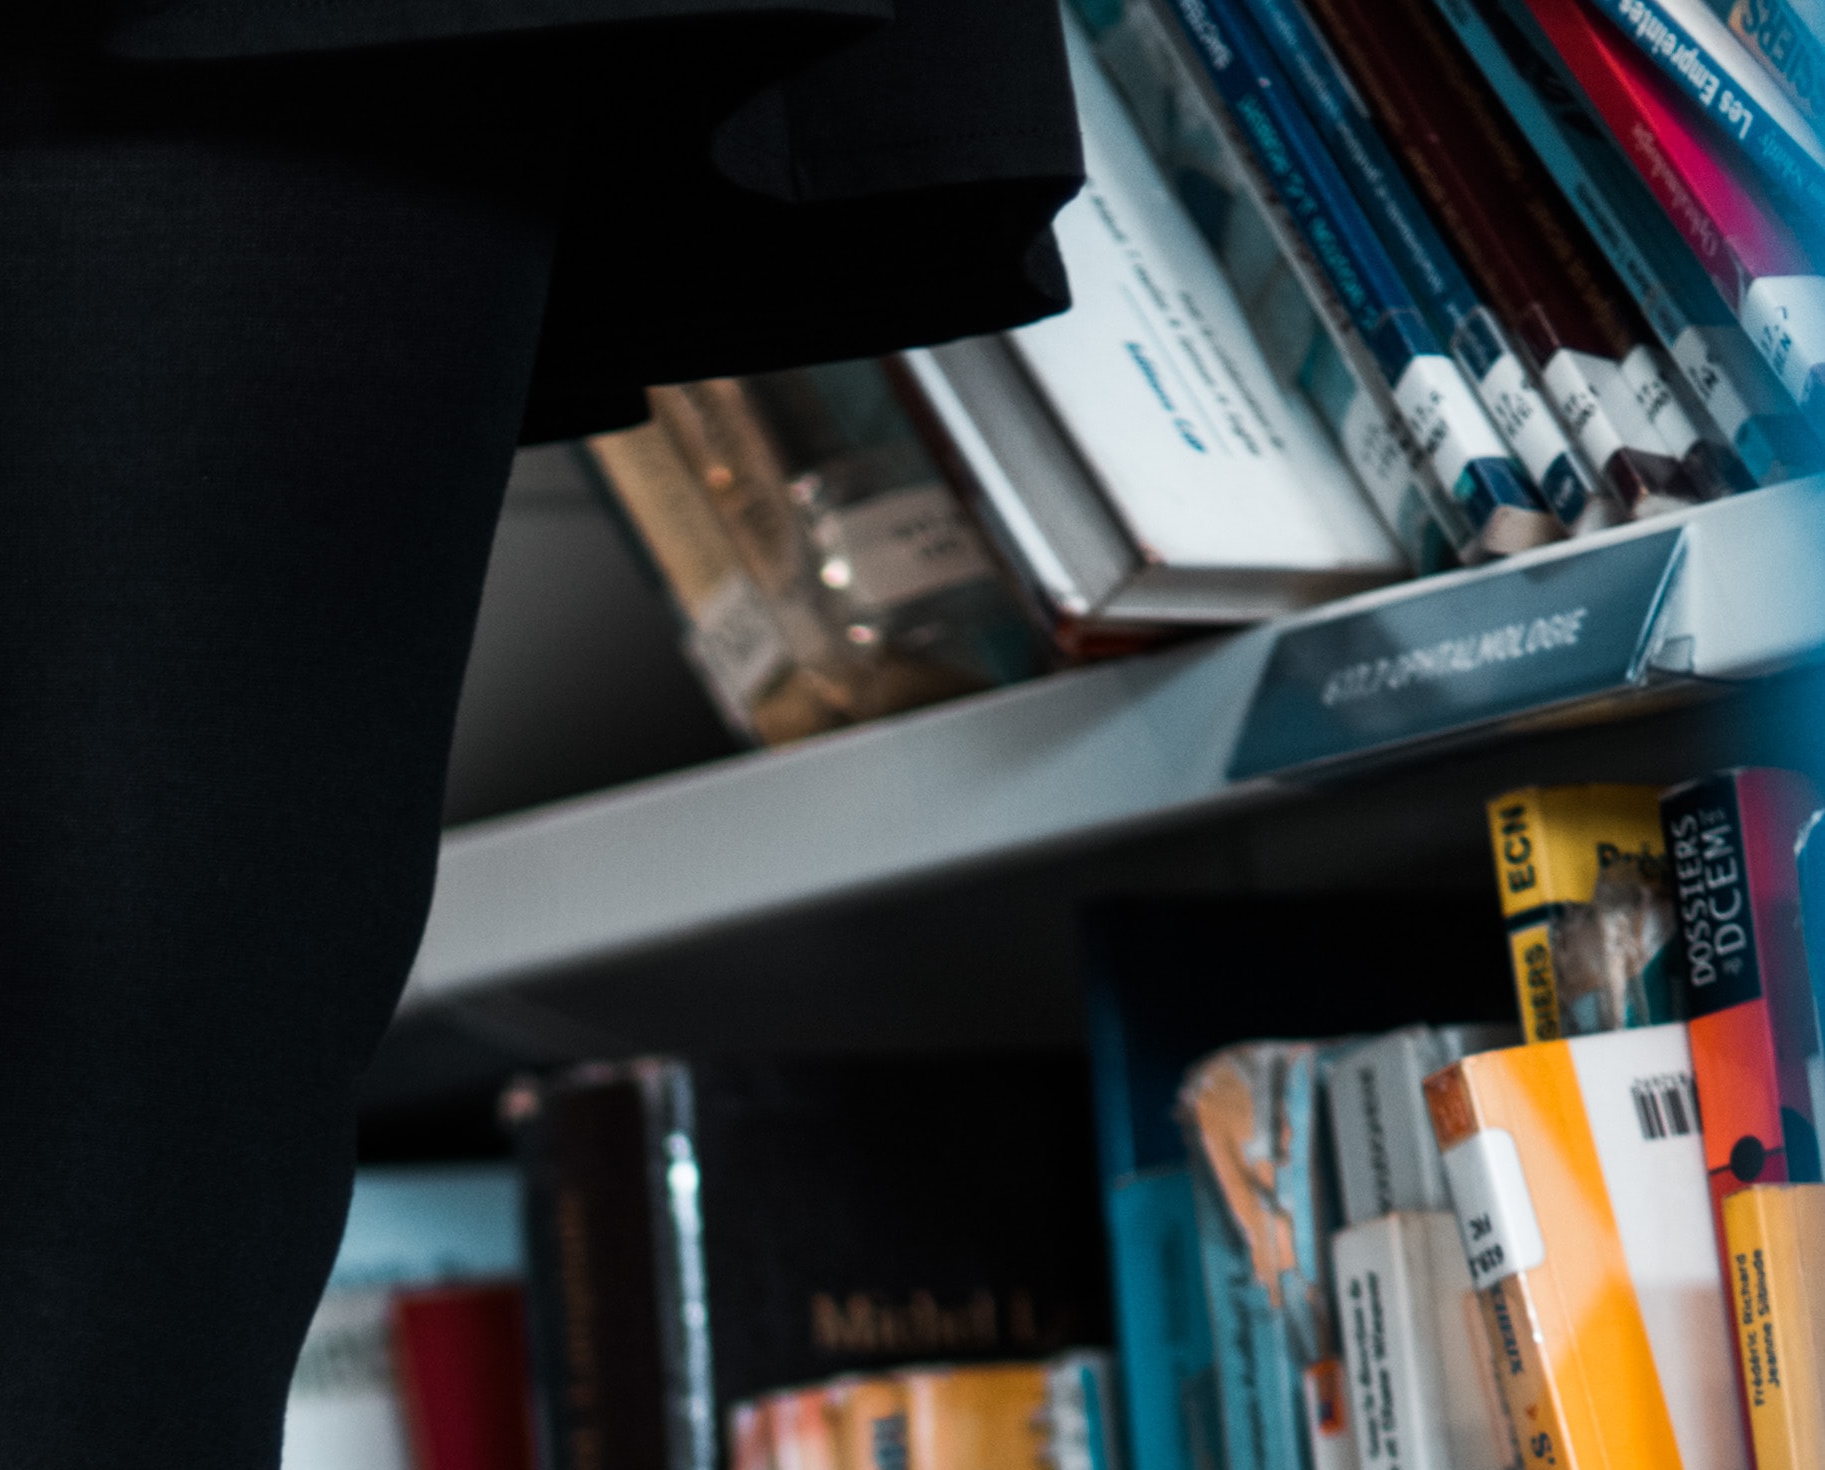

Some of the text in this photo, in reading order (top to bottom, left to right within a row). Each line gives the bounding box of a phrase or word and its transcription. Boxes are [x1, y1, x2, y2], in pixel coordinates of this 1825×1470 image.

[1719, 90, 1753, 139] Les
[1501, 803, 1536, 894] ECN
[1673, 813, 1718, 987] DOSSIERS
[1703, 821, 1747, 956] DCEM
[1735, 1253, 1765, 1407] Frédéric Richard
